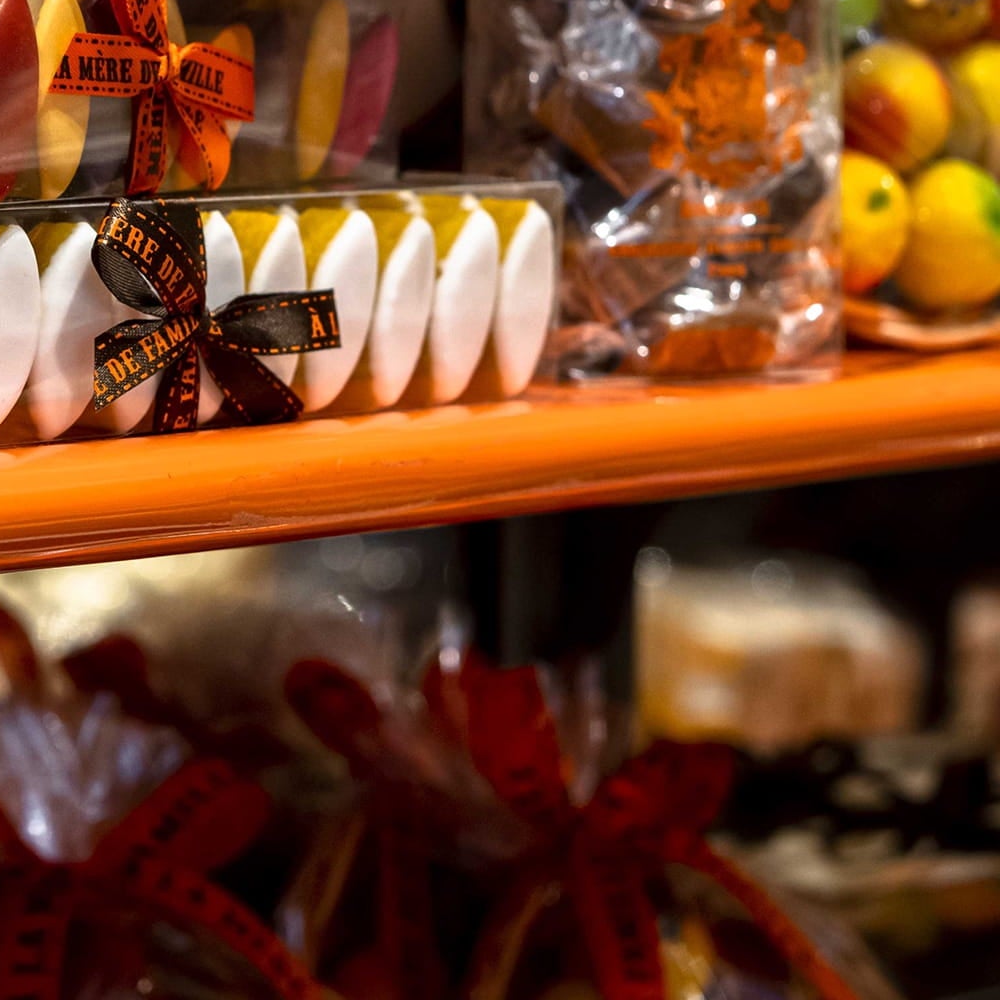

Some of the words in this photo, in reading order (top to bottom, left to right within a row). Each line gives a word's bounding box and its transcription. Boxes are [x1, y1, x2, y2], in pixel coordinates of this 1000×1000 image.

[78, 49, 133, 83] MÈRE
[157, 254, 184, 292] DE
[307, 306, 327, 338] À
[104, 348, 141, 383] DE
